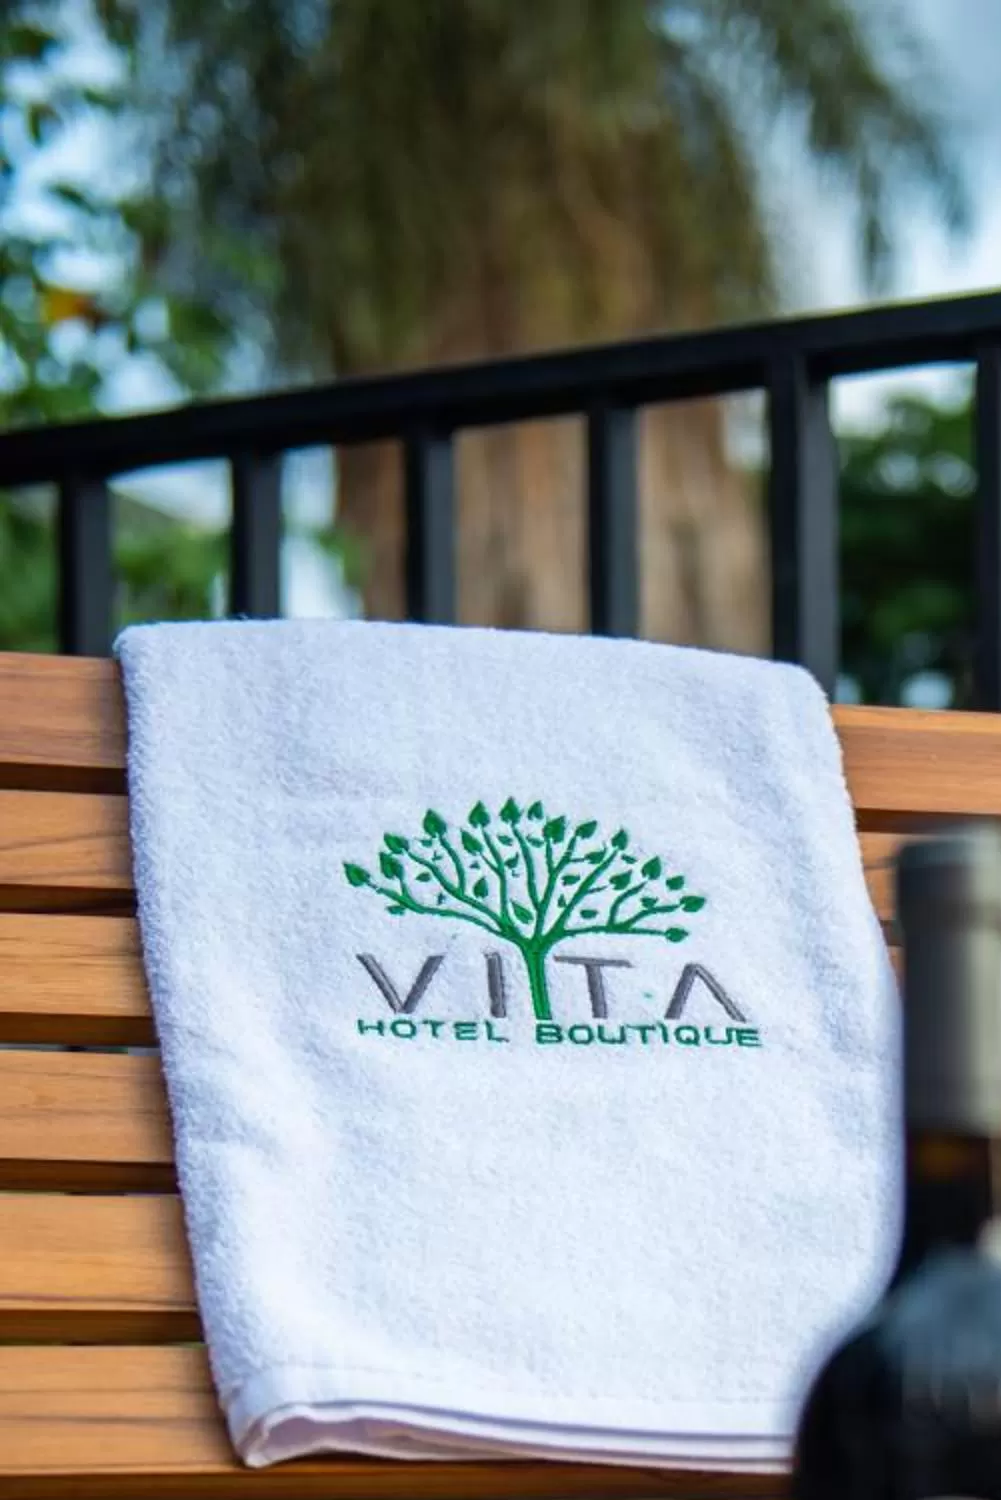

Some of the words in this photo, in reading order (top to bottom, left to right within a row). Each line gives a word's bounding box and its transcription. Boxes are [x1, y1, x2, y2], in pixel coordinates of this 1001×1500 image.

[356, 952, 747, 1022] VITA
[357, 1018, 509, 1043] HOTEL
[535, 1022, 763, 1048] BOUTIQUE
